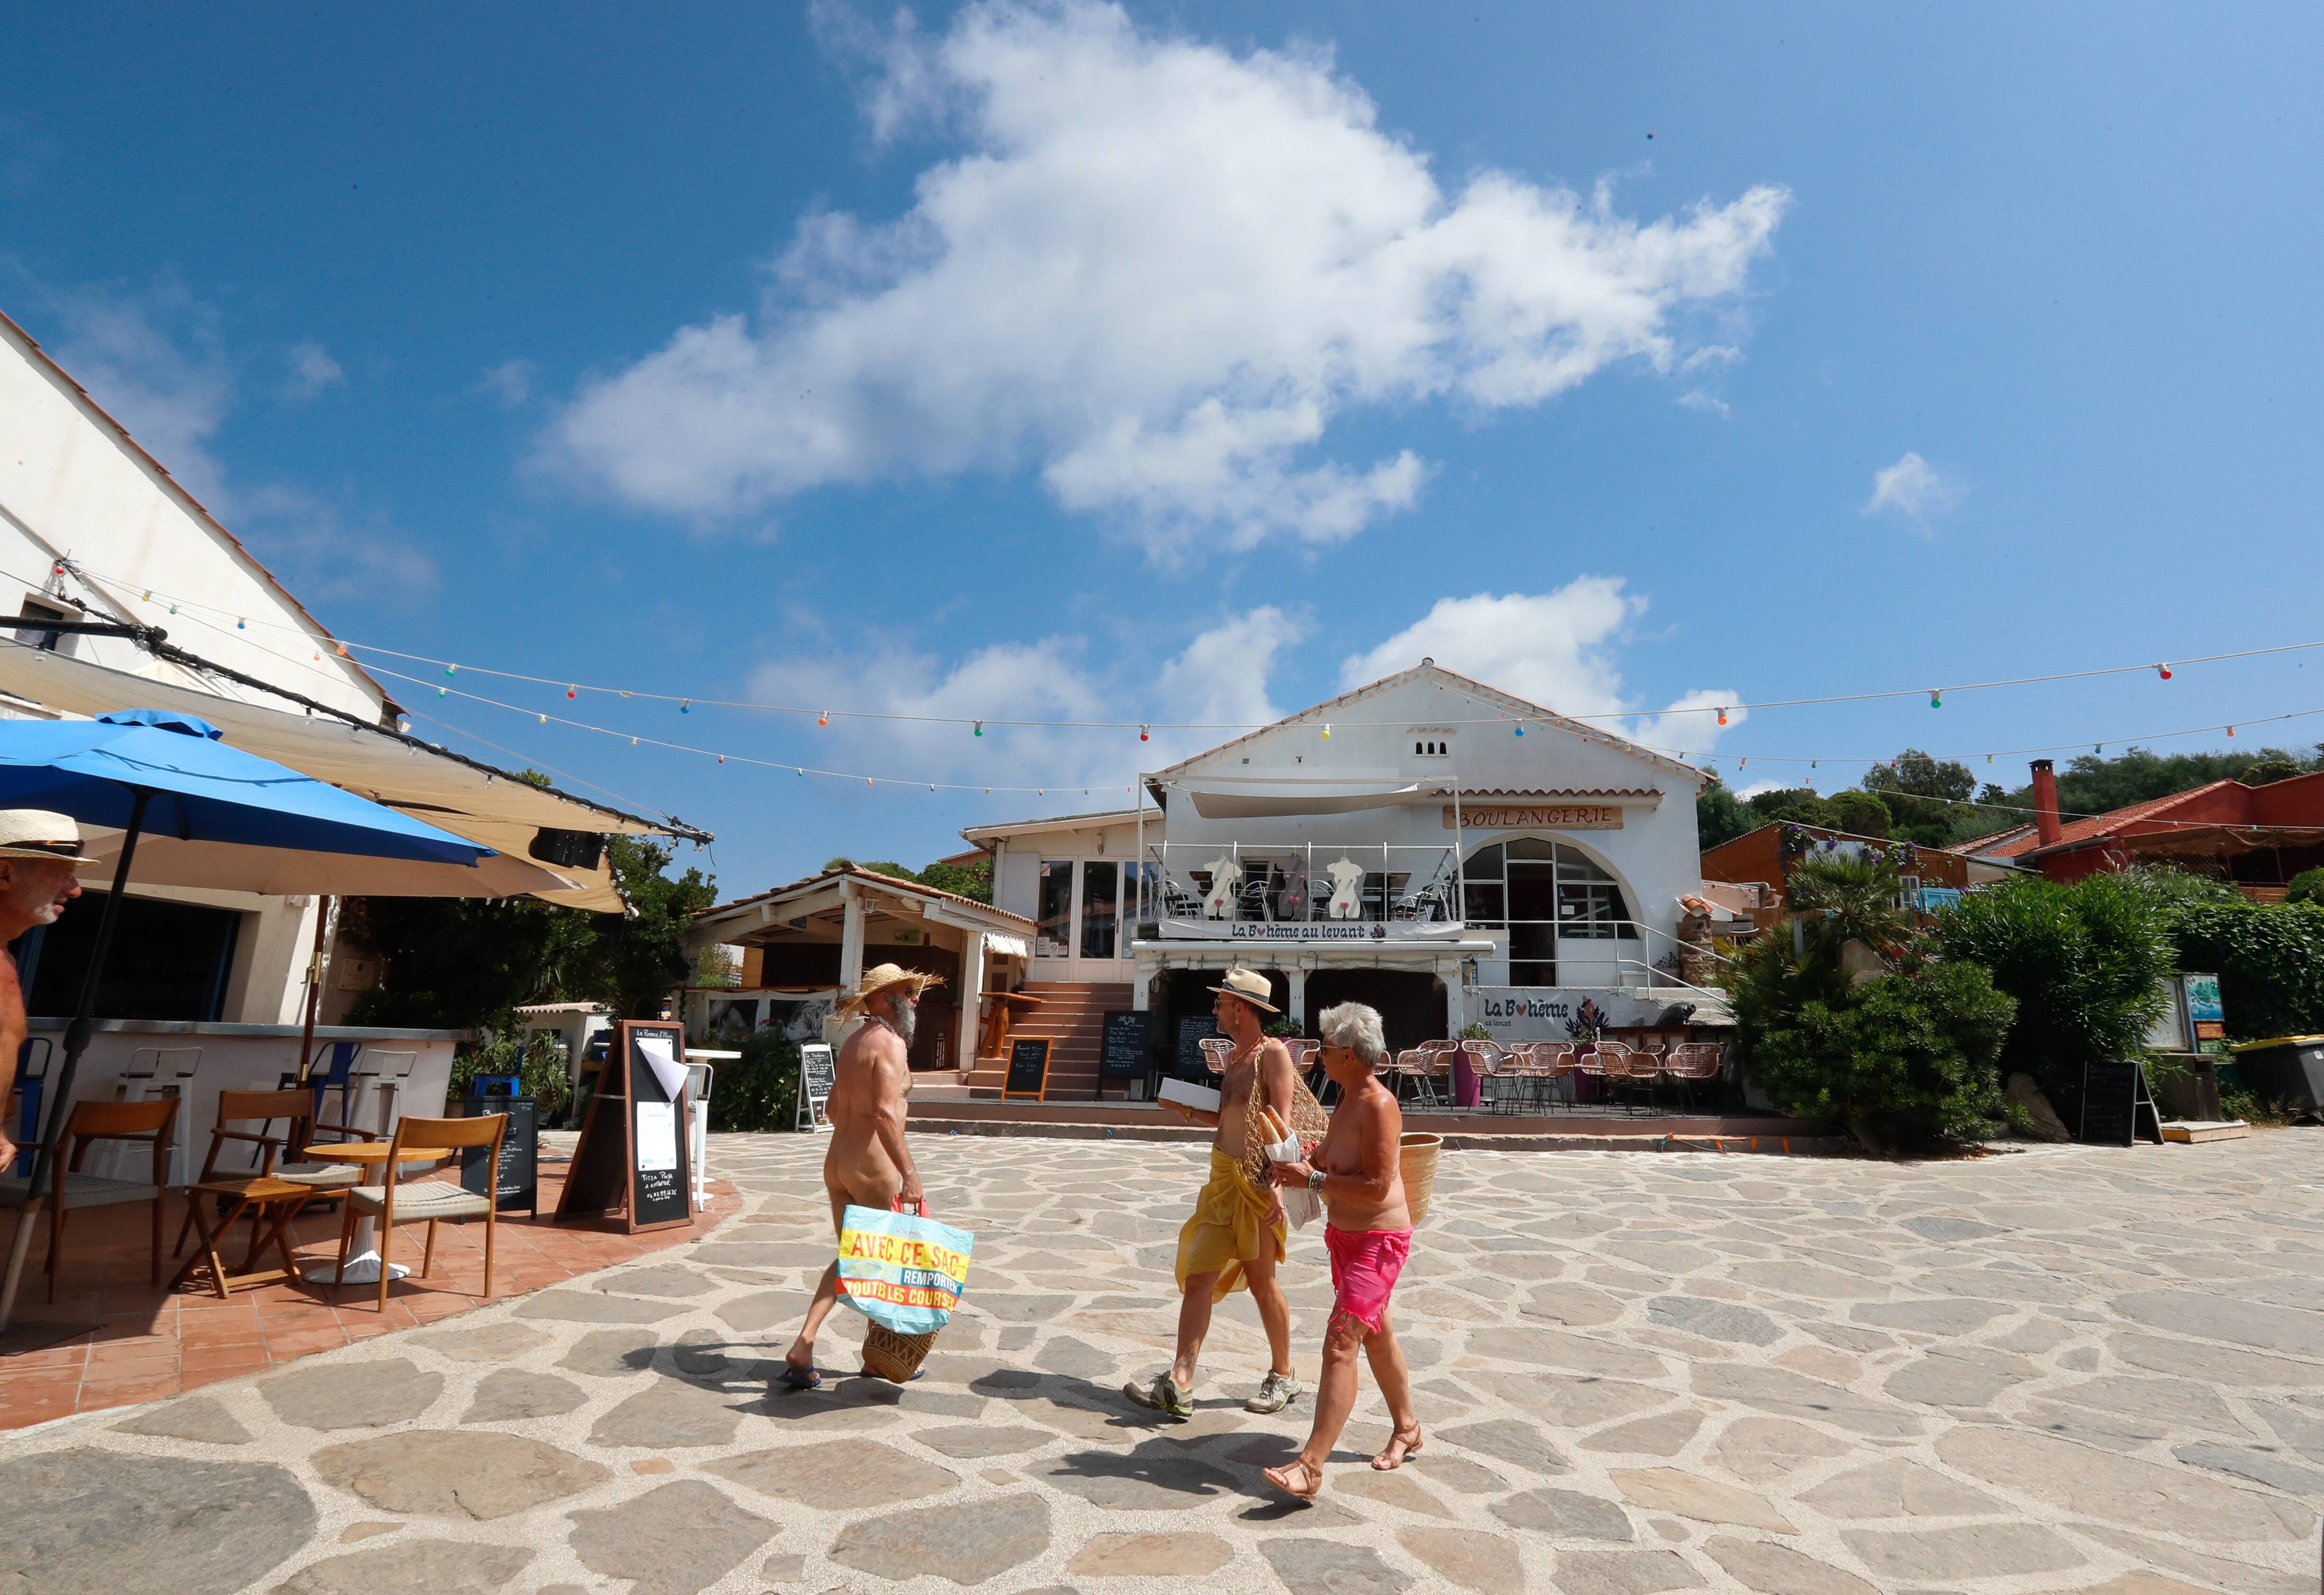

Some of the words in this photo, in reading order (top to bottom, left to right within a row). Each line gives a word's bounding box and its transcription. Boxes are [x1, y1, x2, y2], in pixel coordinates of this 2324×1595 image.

[1452, 807, 1612, 827] BOULANGERIE
[1302, 927, 1319, 938] au
[1321, 924, 1365, 938] levant
[850, 1233, 894, 1262] AVEC
[900, 1242, 924, 1266] CE
[931, 1246, 959, 1277] SAC
[903, 1270, 958, 1294] REMPORTER
[846, 1280, 886, 1299] TOUTES
[888, 1287, 905, 1303] LES
[908, 1288, 954, 1312] COURSES
